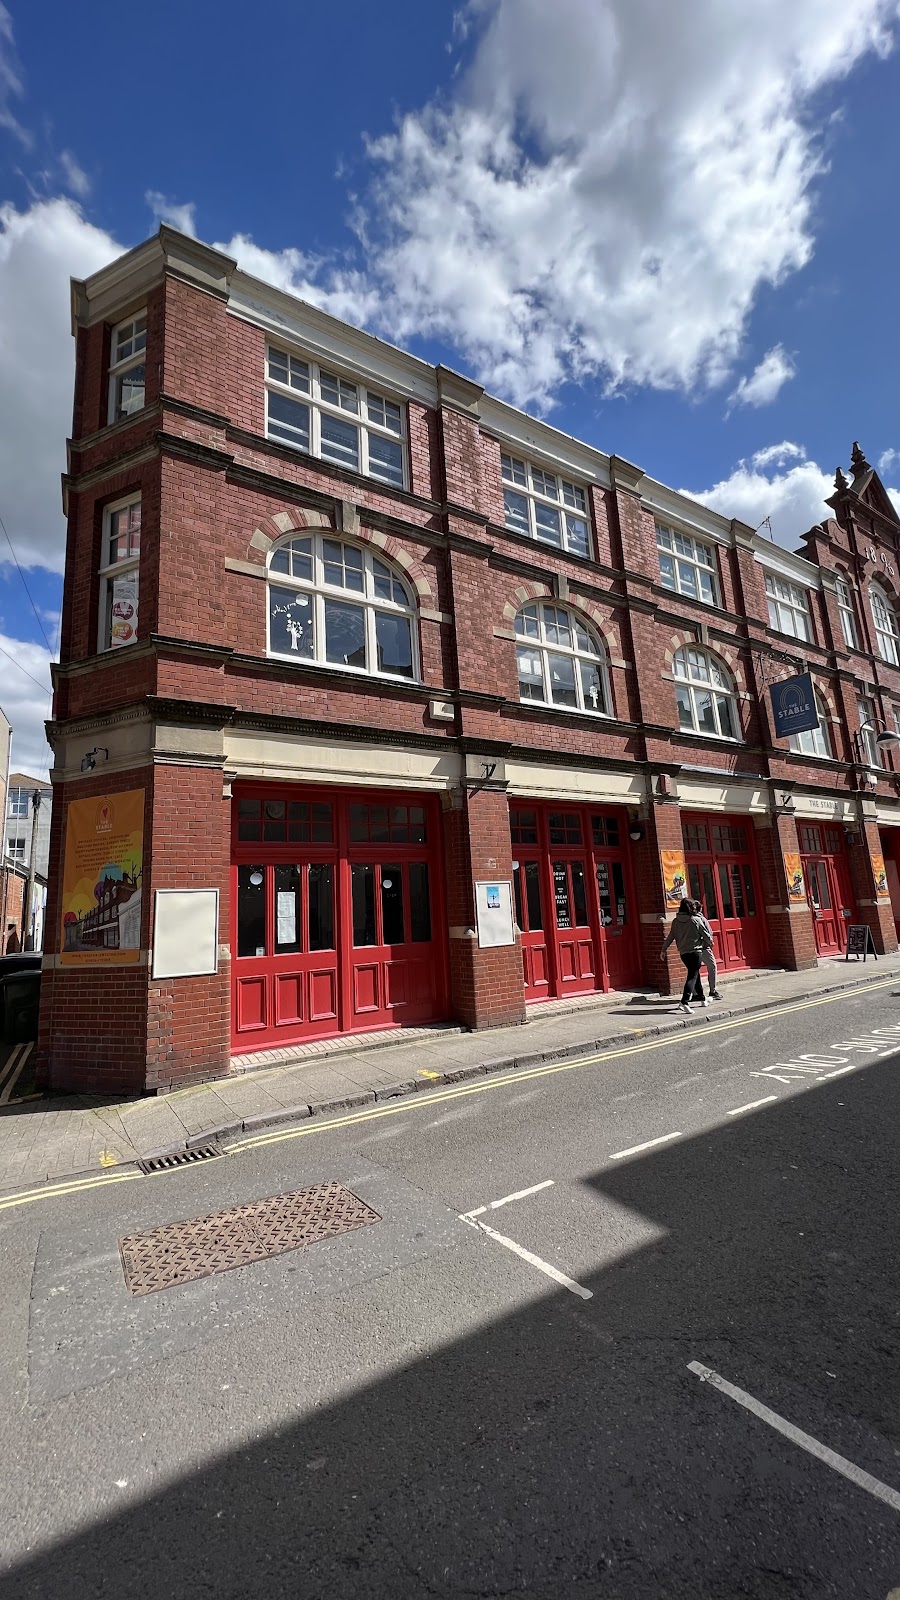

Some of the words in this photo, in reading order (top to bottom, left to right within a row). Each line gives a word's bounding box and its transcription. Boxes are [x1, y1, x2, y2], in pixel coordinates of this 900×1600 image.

[778, 704, 810, 718] STABLE
[820, 801, 838, 809] STABLE
[749, 1054, 850, 1083] ONLY
